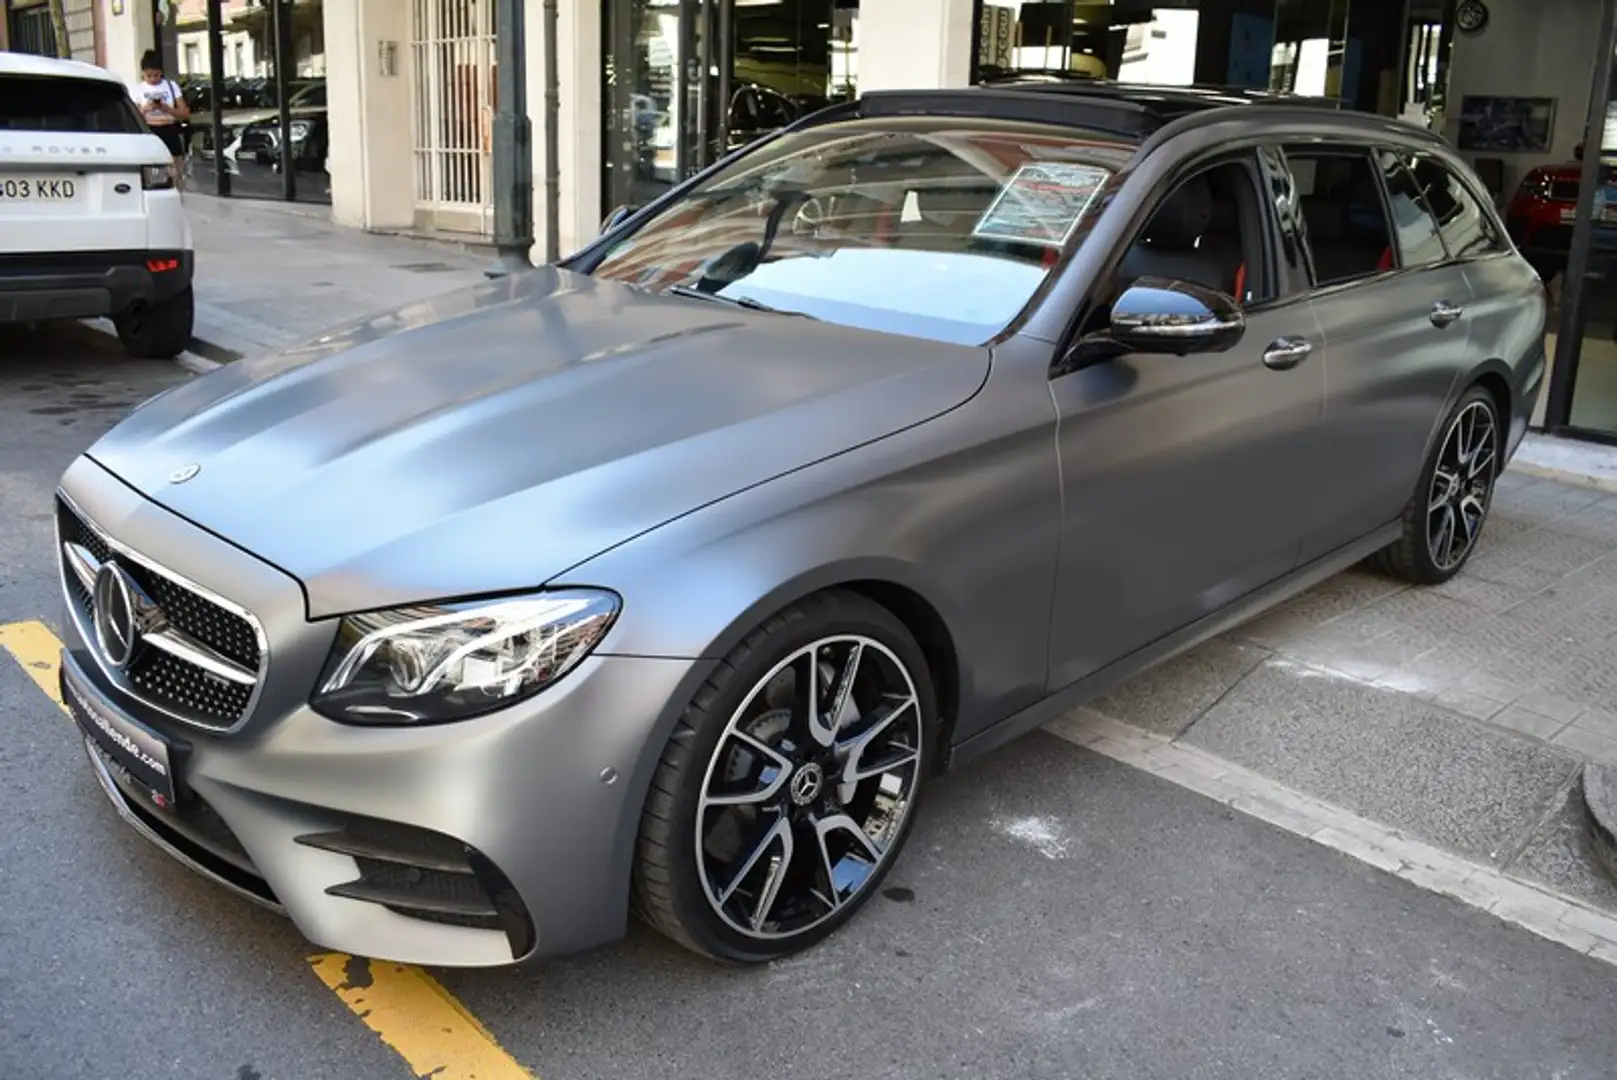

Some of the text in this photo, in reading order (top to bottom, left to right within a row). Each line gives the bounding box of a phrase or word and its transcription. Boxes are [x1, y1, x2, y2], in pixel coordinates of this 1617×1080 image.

[32, 145, 107, 155] ROVER
[0, 179, 75, 198] 03 KKD
